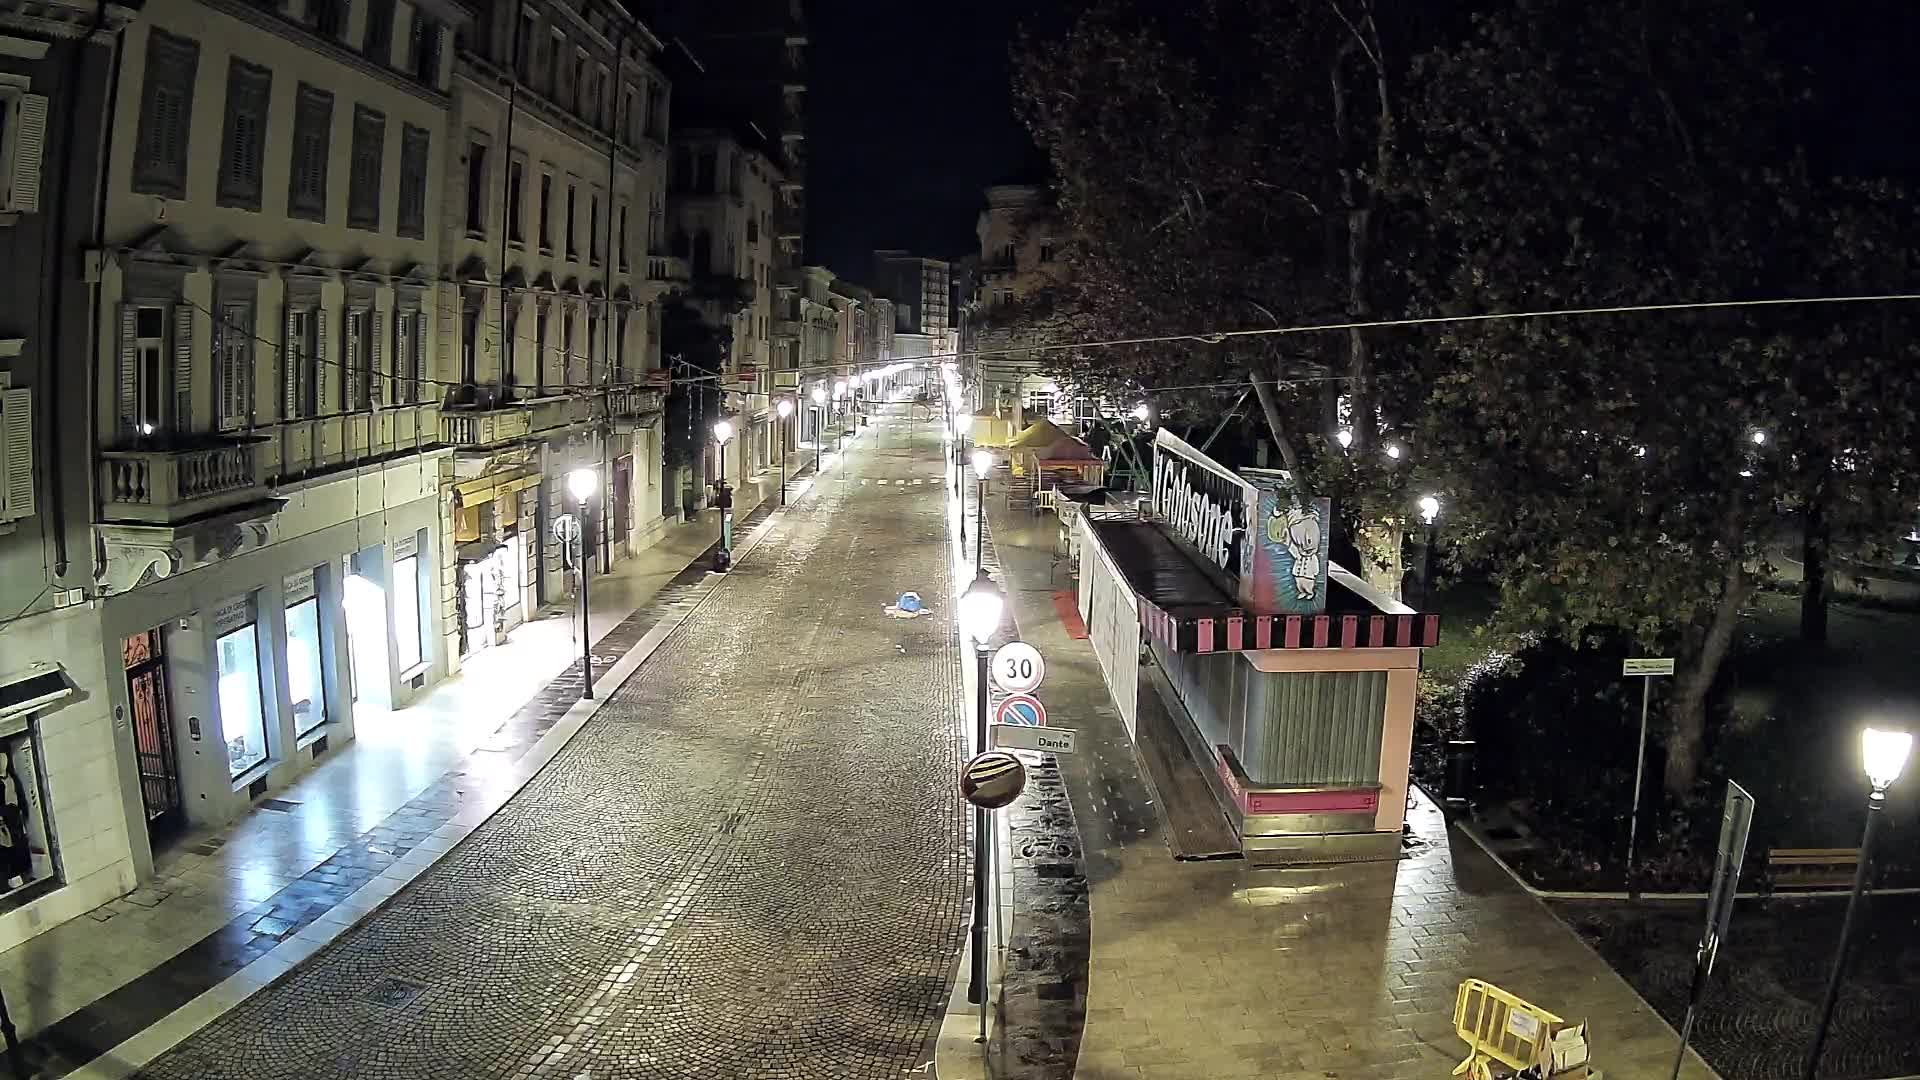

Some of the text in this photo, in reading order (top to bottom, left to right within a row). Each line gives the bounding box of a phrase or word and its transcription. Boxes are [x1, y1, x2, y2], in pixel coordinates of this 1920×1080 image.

[1163, 457, 1233, 570] Golosone
[1006, 658, 1032, 679] 30
[1038, 737, 1070, 749] Dante
